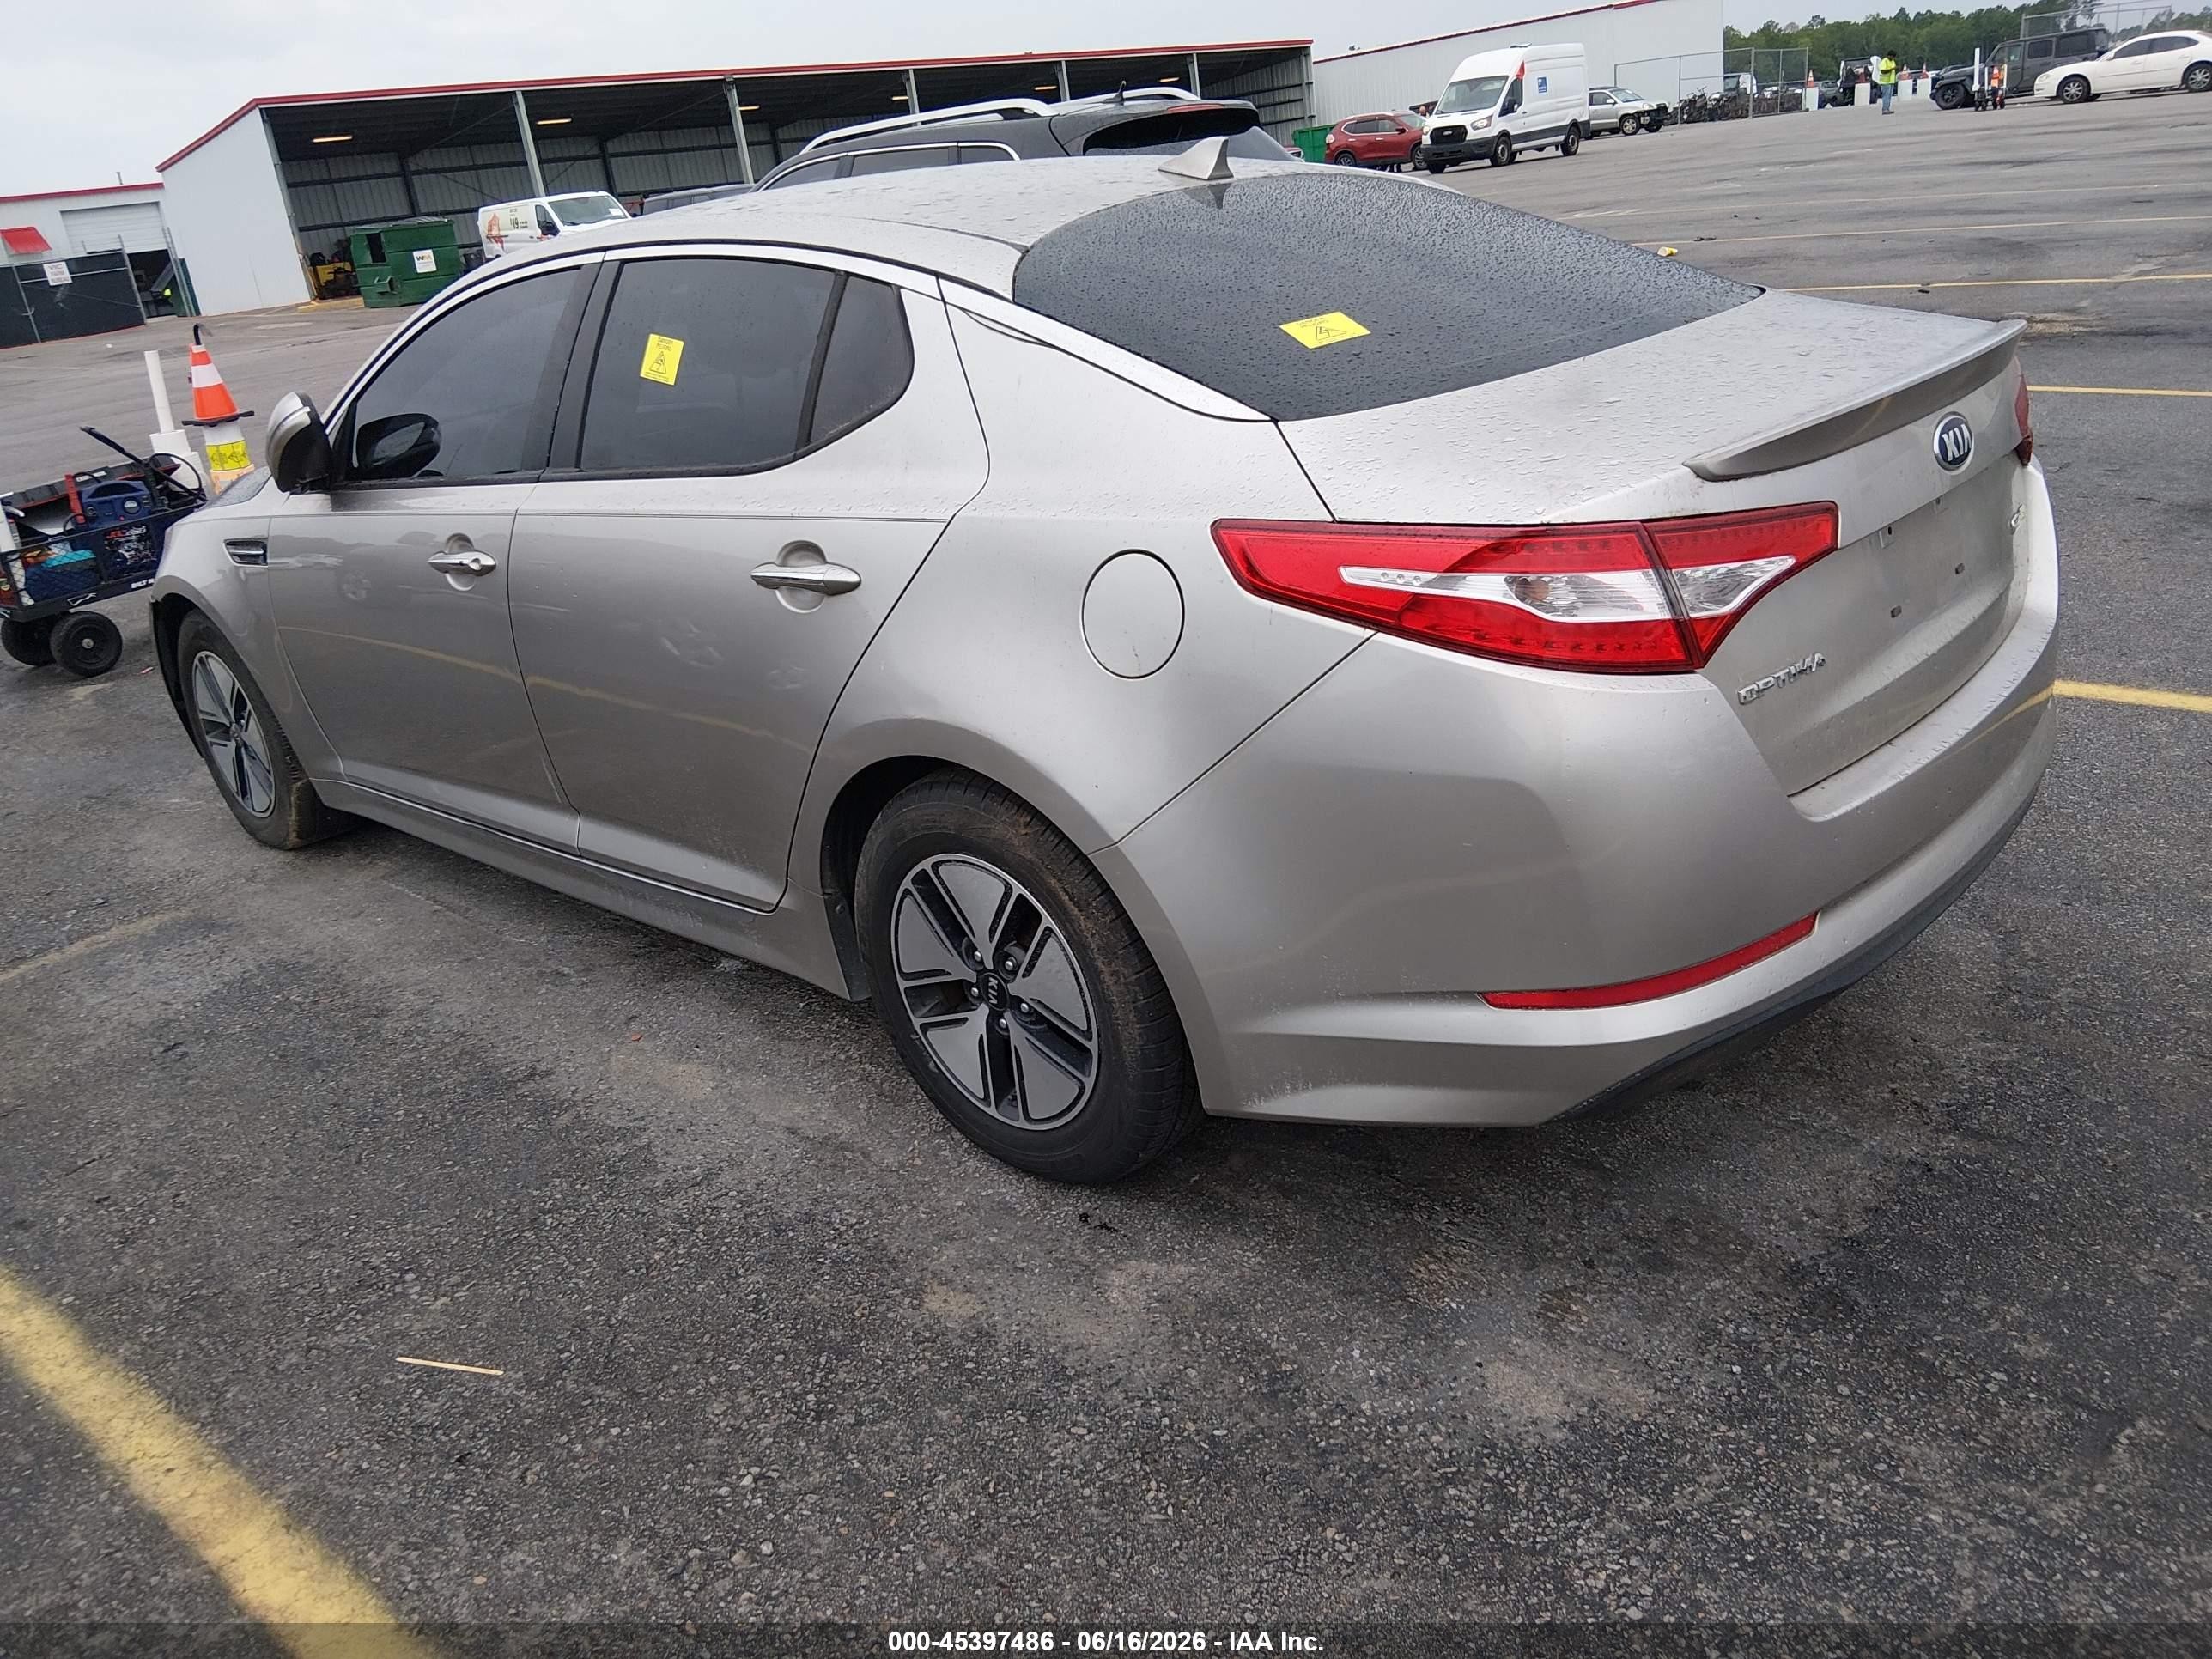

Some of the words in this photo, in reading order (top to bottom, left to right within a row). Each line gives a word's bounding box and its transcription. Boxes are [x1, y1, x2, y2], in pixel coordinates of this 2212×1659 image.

[1942, 424, 1972, 461] KIA
[1737, 652, 1826, 705] OPTIMA
[988, 976, 999, 1005] KIA
